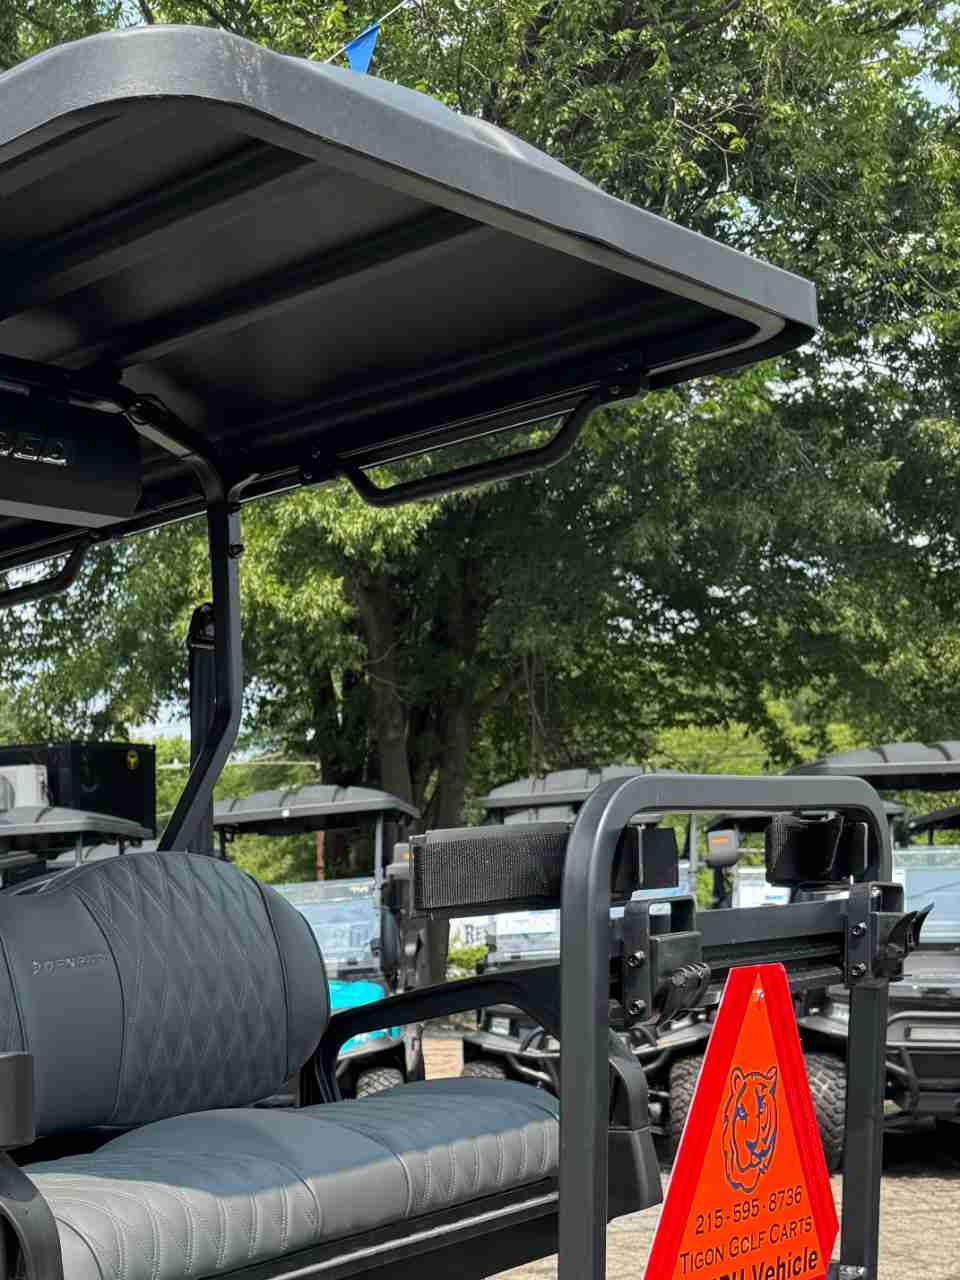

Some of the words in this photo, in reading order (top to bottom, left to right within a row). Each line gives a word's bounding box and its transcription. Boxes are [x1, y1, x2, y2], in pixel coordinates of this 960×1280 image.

[680, 1247, 724, 1274] TIGON
[729, 1231, 766, 1257] GOLF
[769, 1217, 812, 1244] CARTS
